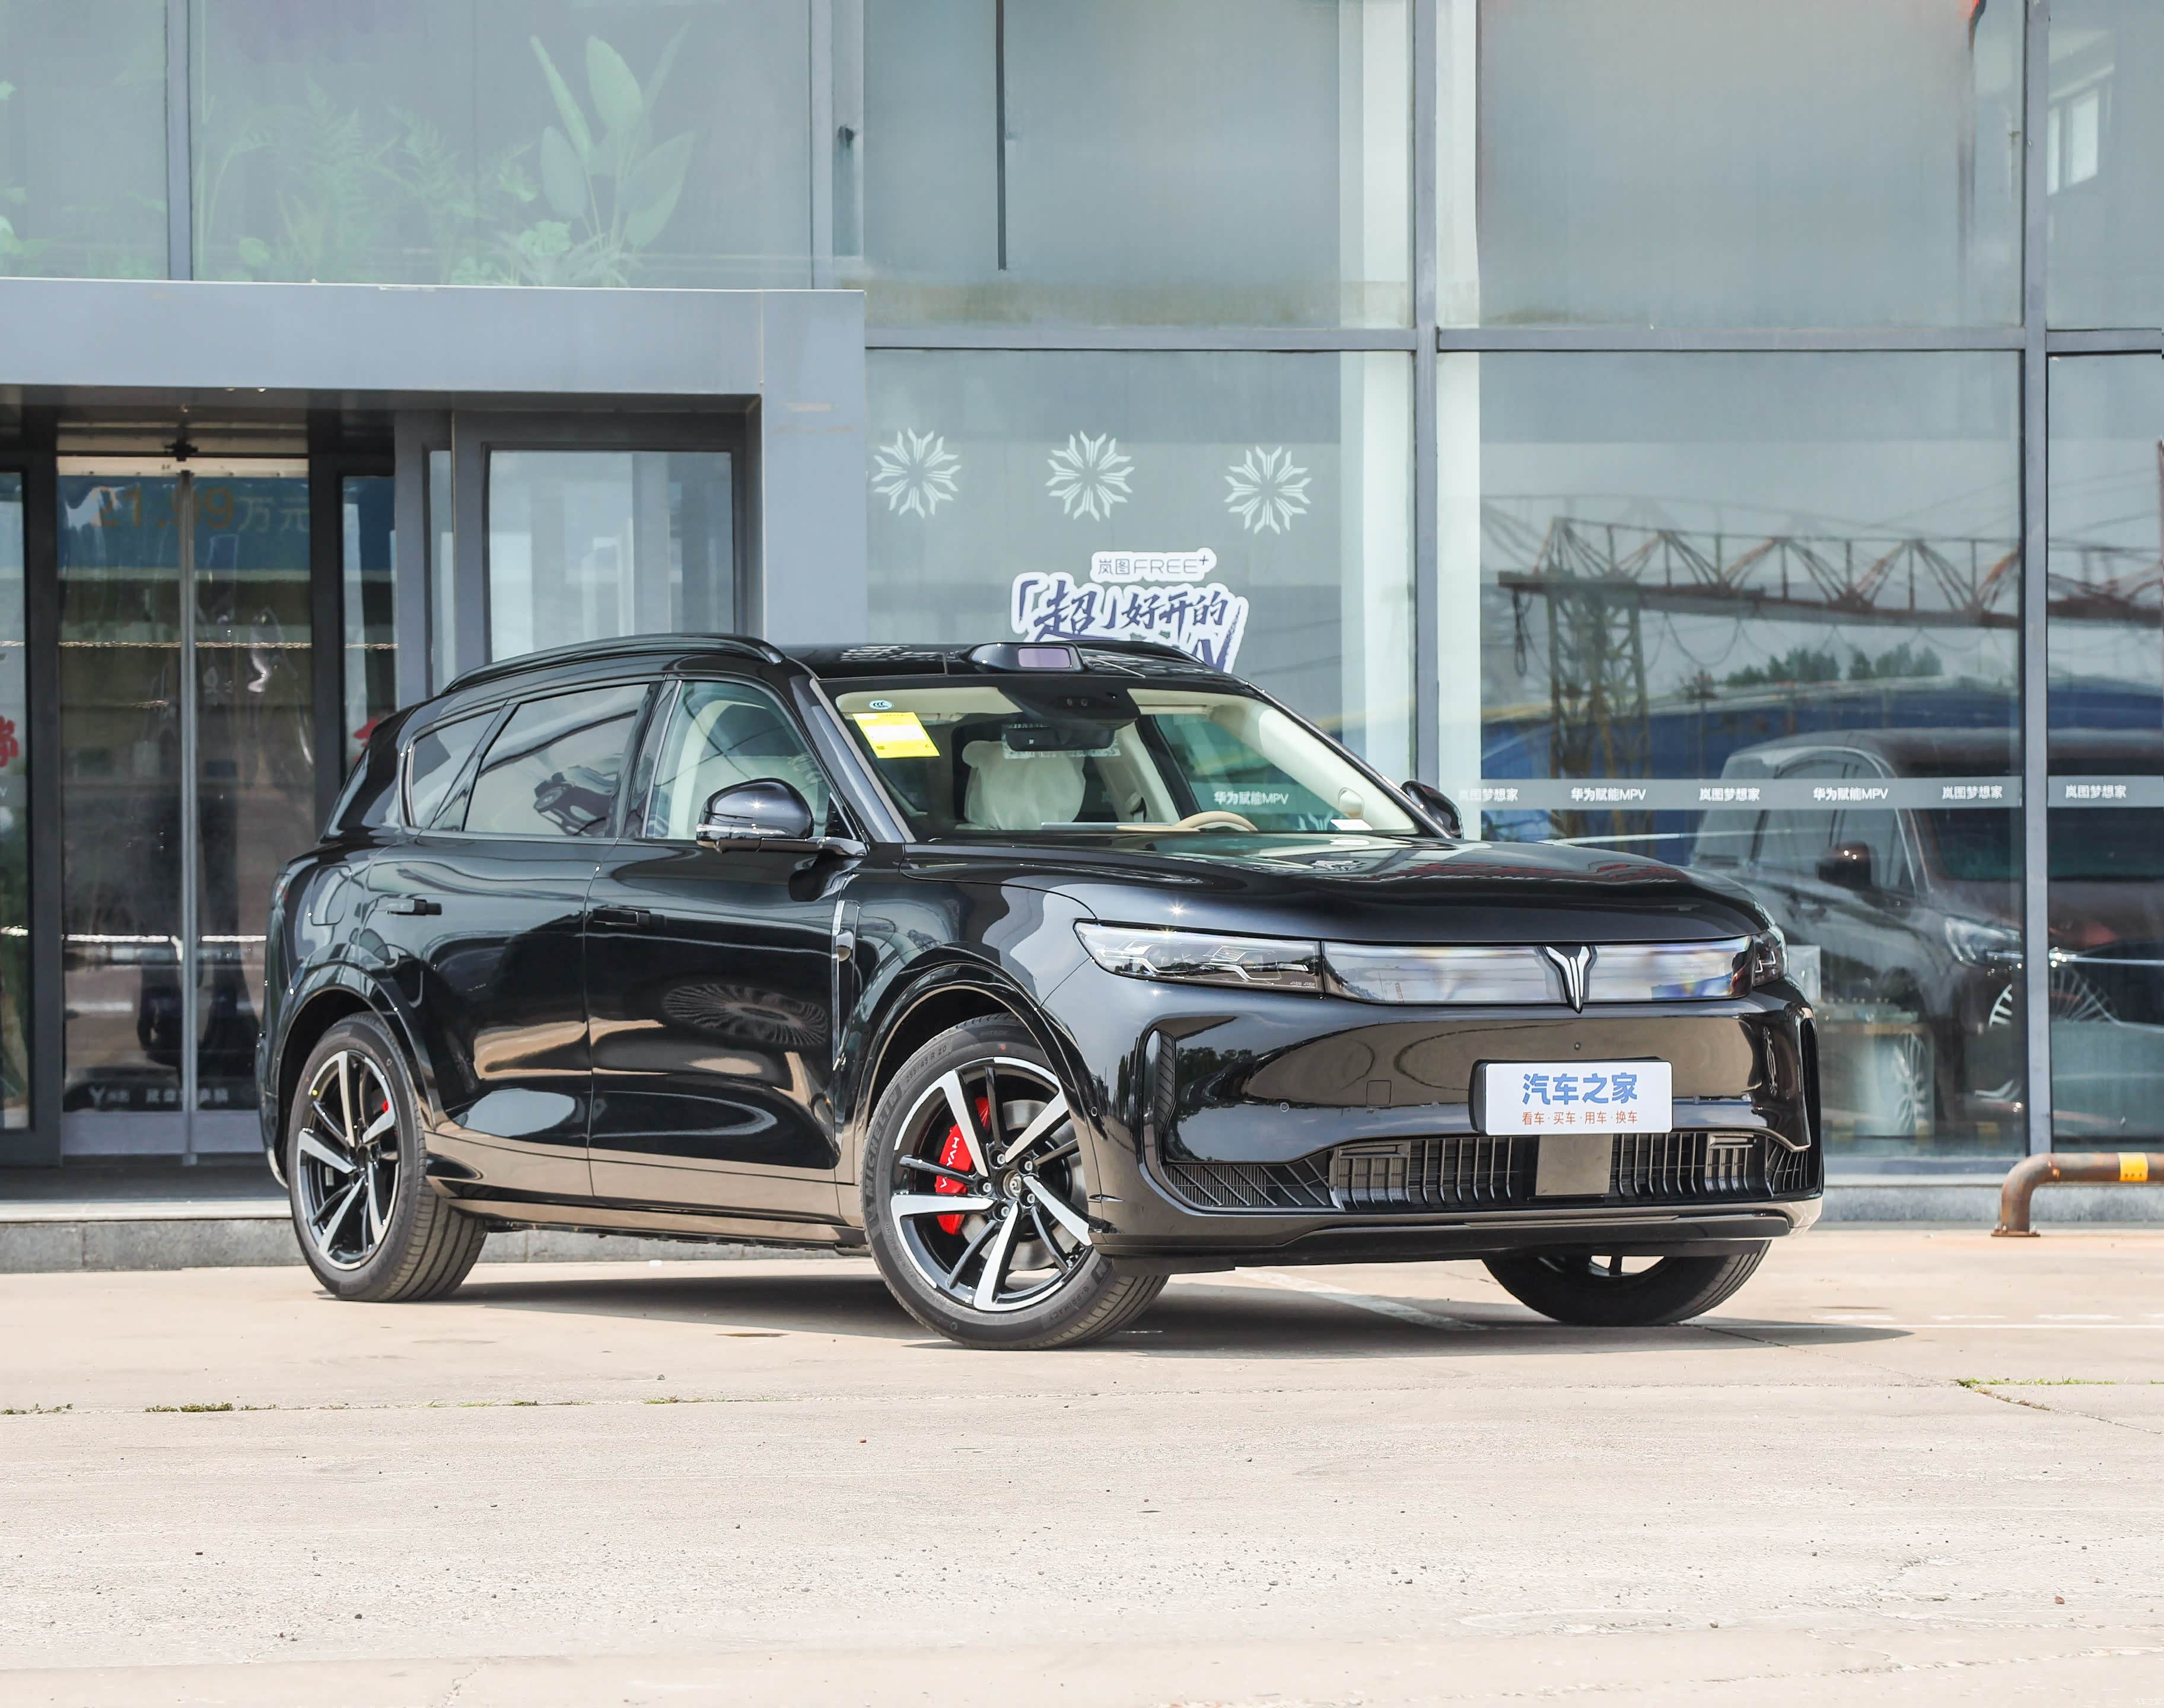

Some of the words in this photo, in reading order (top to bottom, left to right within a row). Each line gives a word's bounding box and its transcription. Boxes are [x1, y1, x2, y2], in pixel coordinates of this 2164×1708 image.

[1214, 791, 1289, 805] 华为赋能MPV
[1570, 787, 1647, 802] 华为赋能MPV
[1699, 788, 1760, 801] 岚图梦想家
[1813, 787, 1889, 801] 华为赋能MPV
[1942, 785, 2003, 800] 岚图梦想家
[2065, 785, 2127, 799] 岚图梦想家
[1522, 1072, 1637, 1105] 汽车之家
[940, 1136, 960, 1188] VYAH
